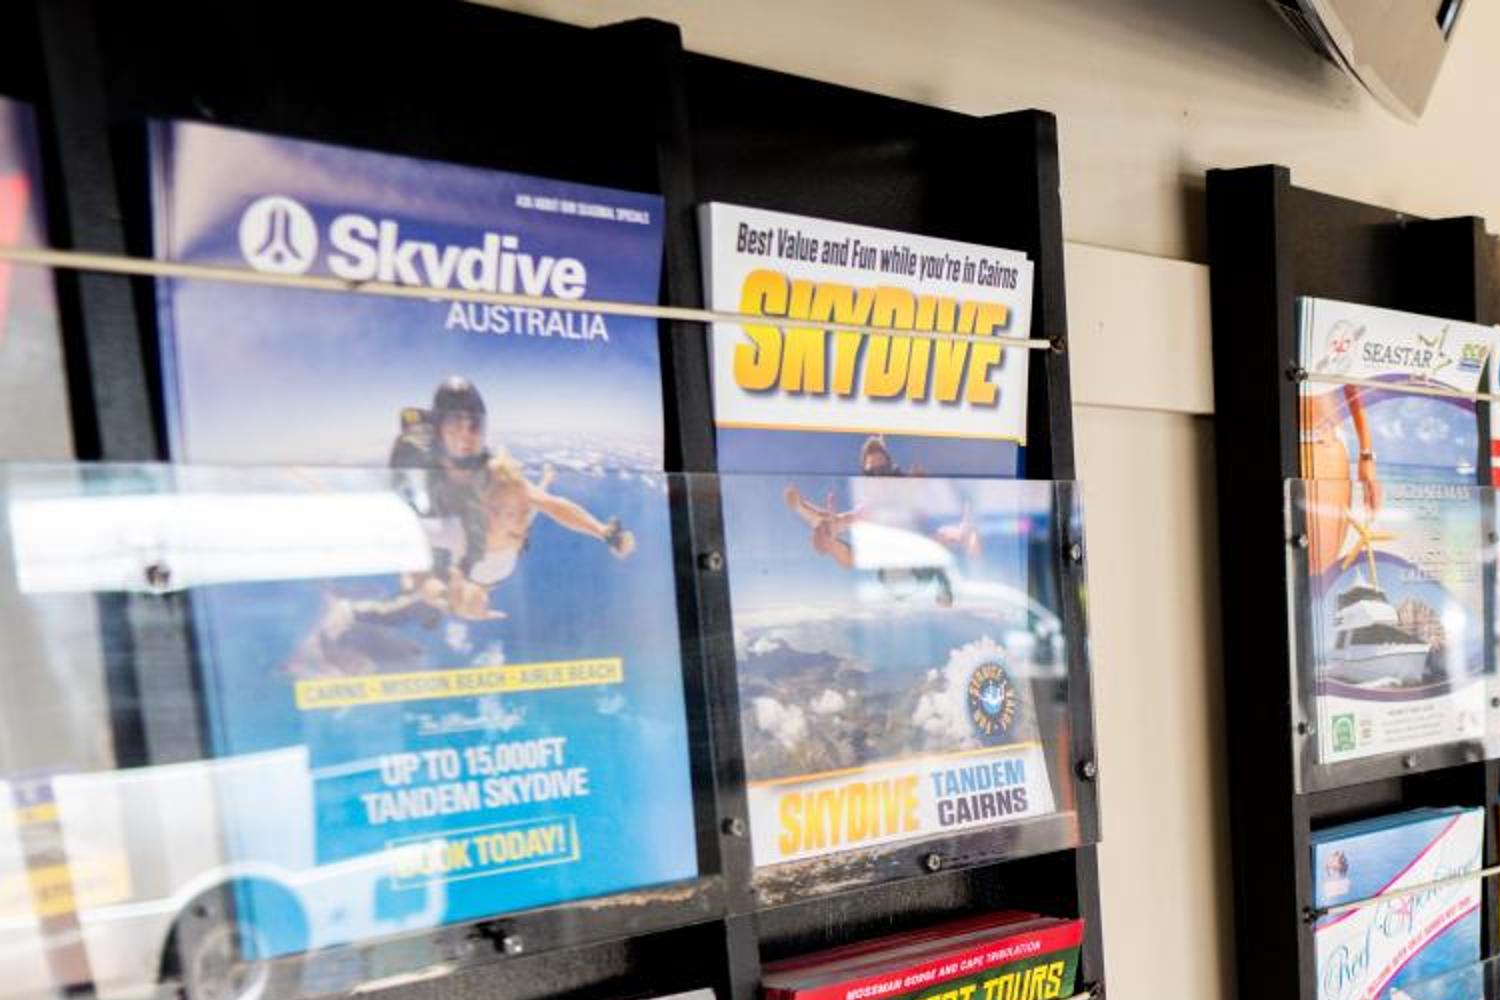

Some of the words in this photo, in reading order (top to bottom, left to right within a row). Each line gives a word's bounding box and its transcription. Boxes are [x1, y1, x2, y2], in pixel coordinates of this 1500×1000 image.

[328, 213, 587, 301] Skydive
[737, 222, 775, 258] Best
[776, 227, 818, 263] Value
[821, 237, 849, 269] and
[852, 238, 877, 272] Fun
[880, 243, 916, 278] while
[919, 252, 961, 284] you're
[963, 253, 977, 284] in
[977, 257, 1019, 291] Cairns
[446, 302, 609, 342] AUSTRALIA
[733, 268, 1010, 406] SKYDIVE
[1363, 341, 1435, 368] SEASTAR
[379, 754, 417, 786] UP
[422, 748, 460, 781] TO
[465, 736, 567, 777] 15,000FT
[930, 759, 1026, 798] TANDEM
[362, 782, 481, 825] TANDEM
[483, 767, 590, 808] SKYDIVE
[777, 774, 921, 857] SKYDIVE
[937, 788, 1029, 828] CAIRNS
[474, 825, 566, 865] TODAY!
[937, 961, 960, 979] AND
